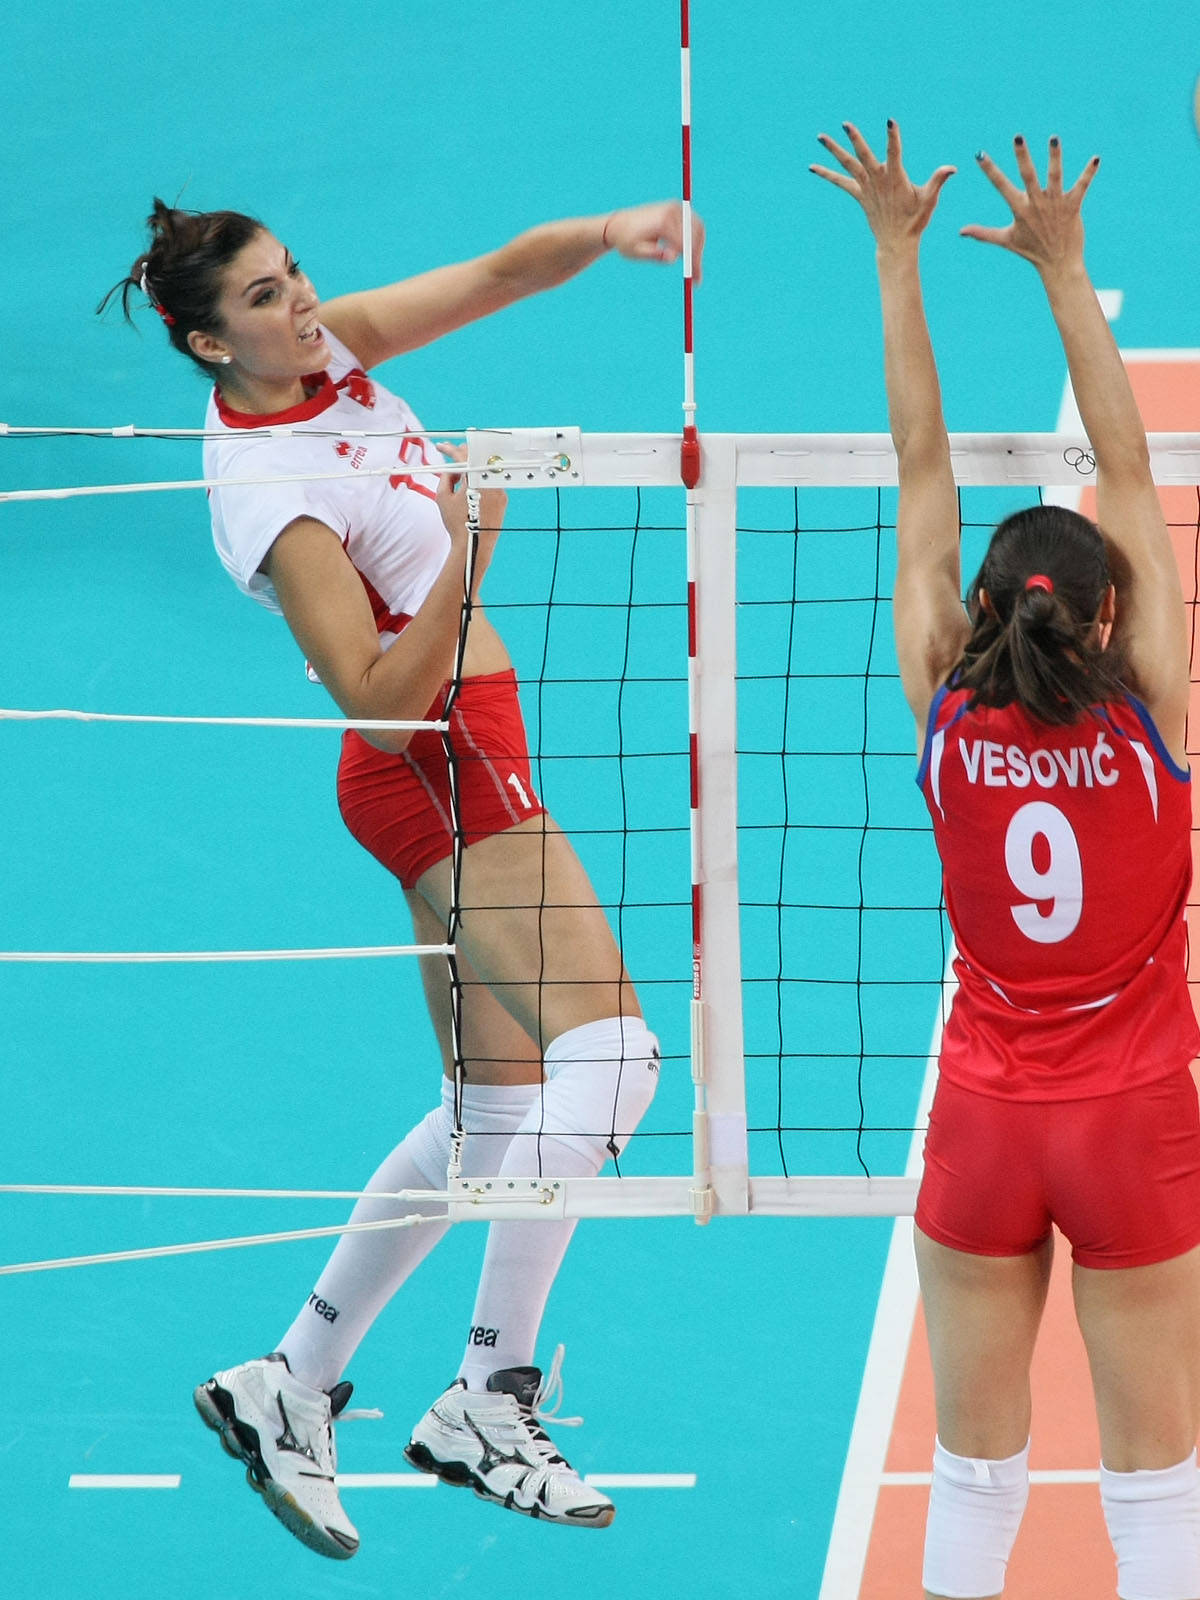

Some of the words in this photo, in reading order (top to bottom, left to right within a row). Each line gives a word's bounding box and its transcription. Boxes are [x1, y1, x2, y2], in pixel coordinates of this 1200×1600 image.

[958, 732, 1120, 788] VESOVIĆ
[1005, 801, 1083, 944] 9
[309, 1293, 338, 1324] rea
[468, 1326, 498, 1348] rea
